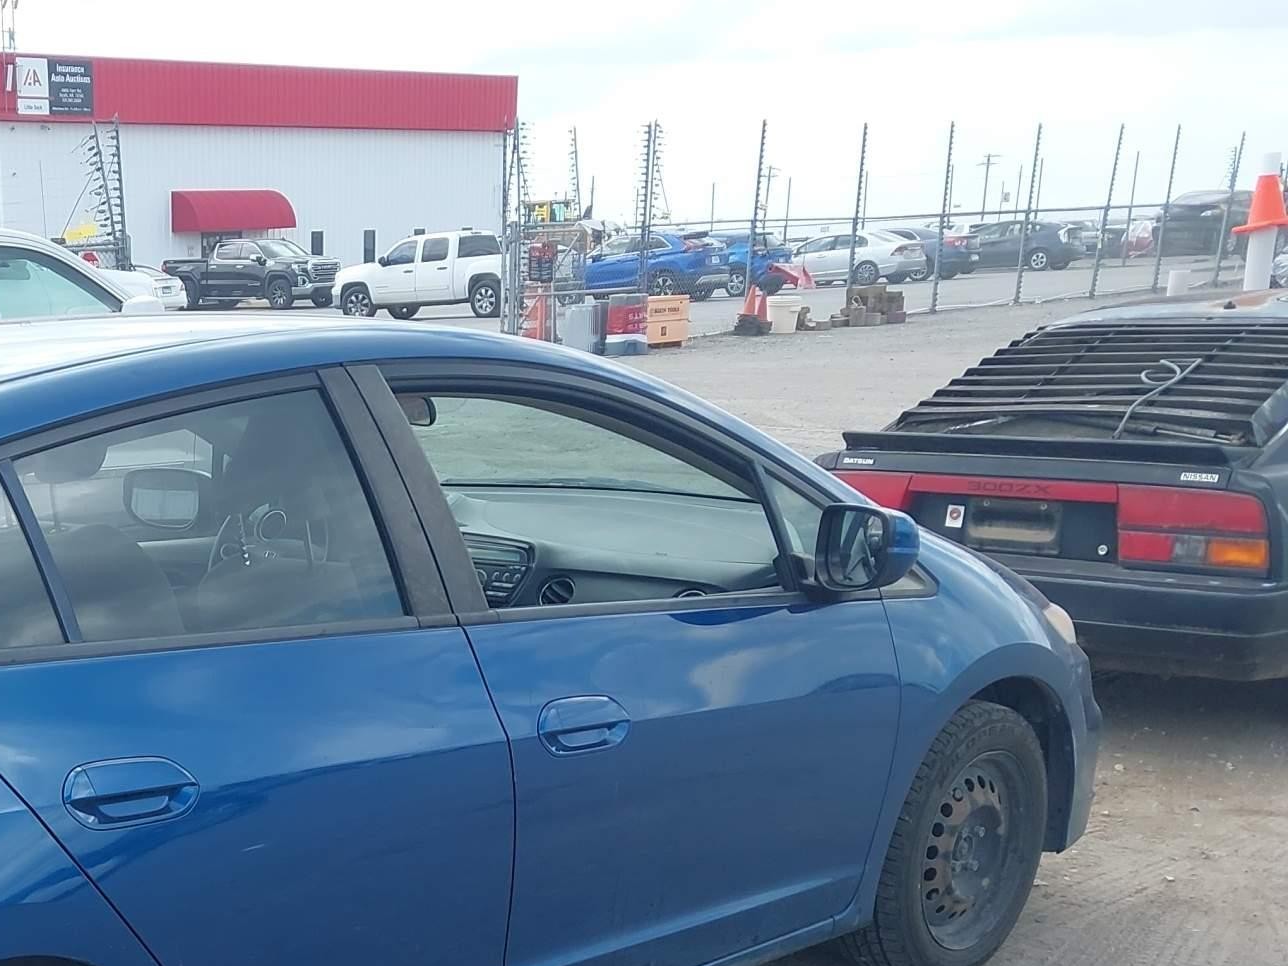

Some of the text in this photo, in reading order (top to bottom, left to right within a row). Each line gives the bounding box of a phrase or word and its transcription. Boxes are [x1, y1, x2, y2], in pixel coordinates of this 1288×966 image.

[65, 74, 91, 84] Auctions
[843, 457, 874, 465] DATSUN
[1182, 473, 1217, 481] NISSAN
[967, 481, 1049, 494] 300ZX
